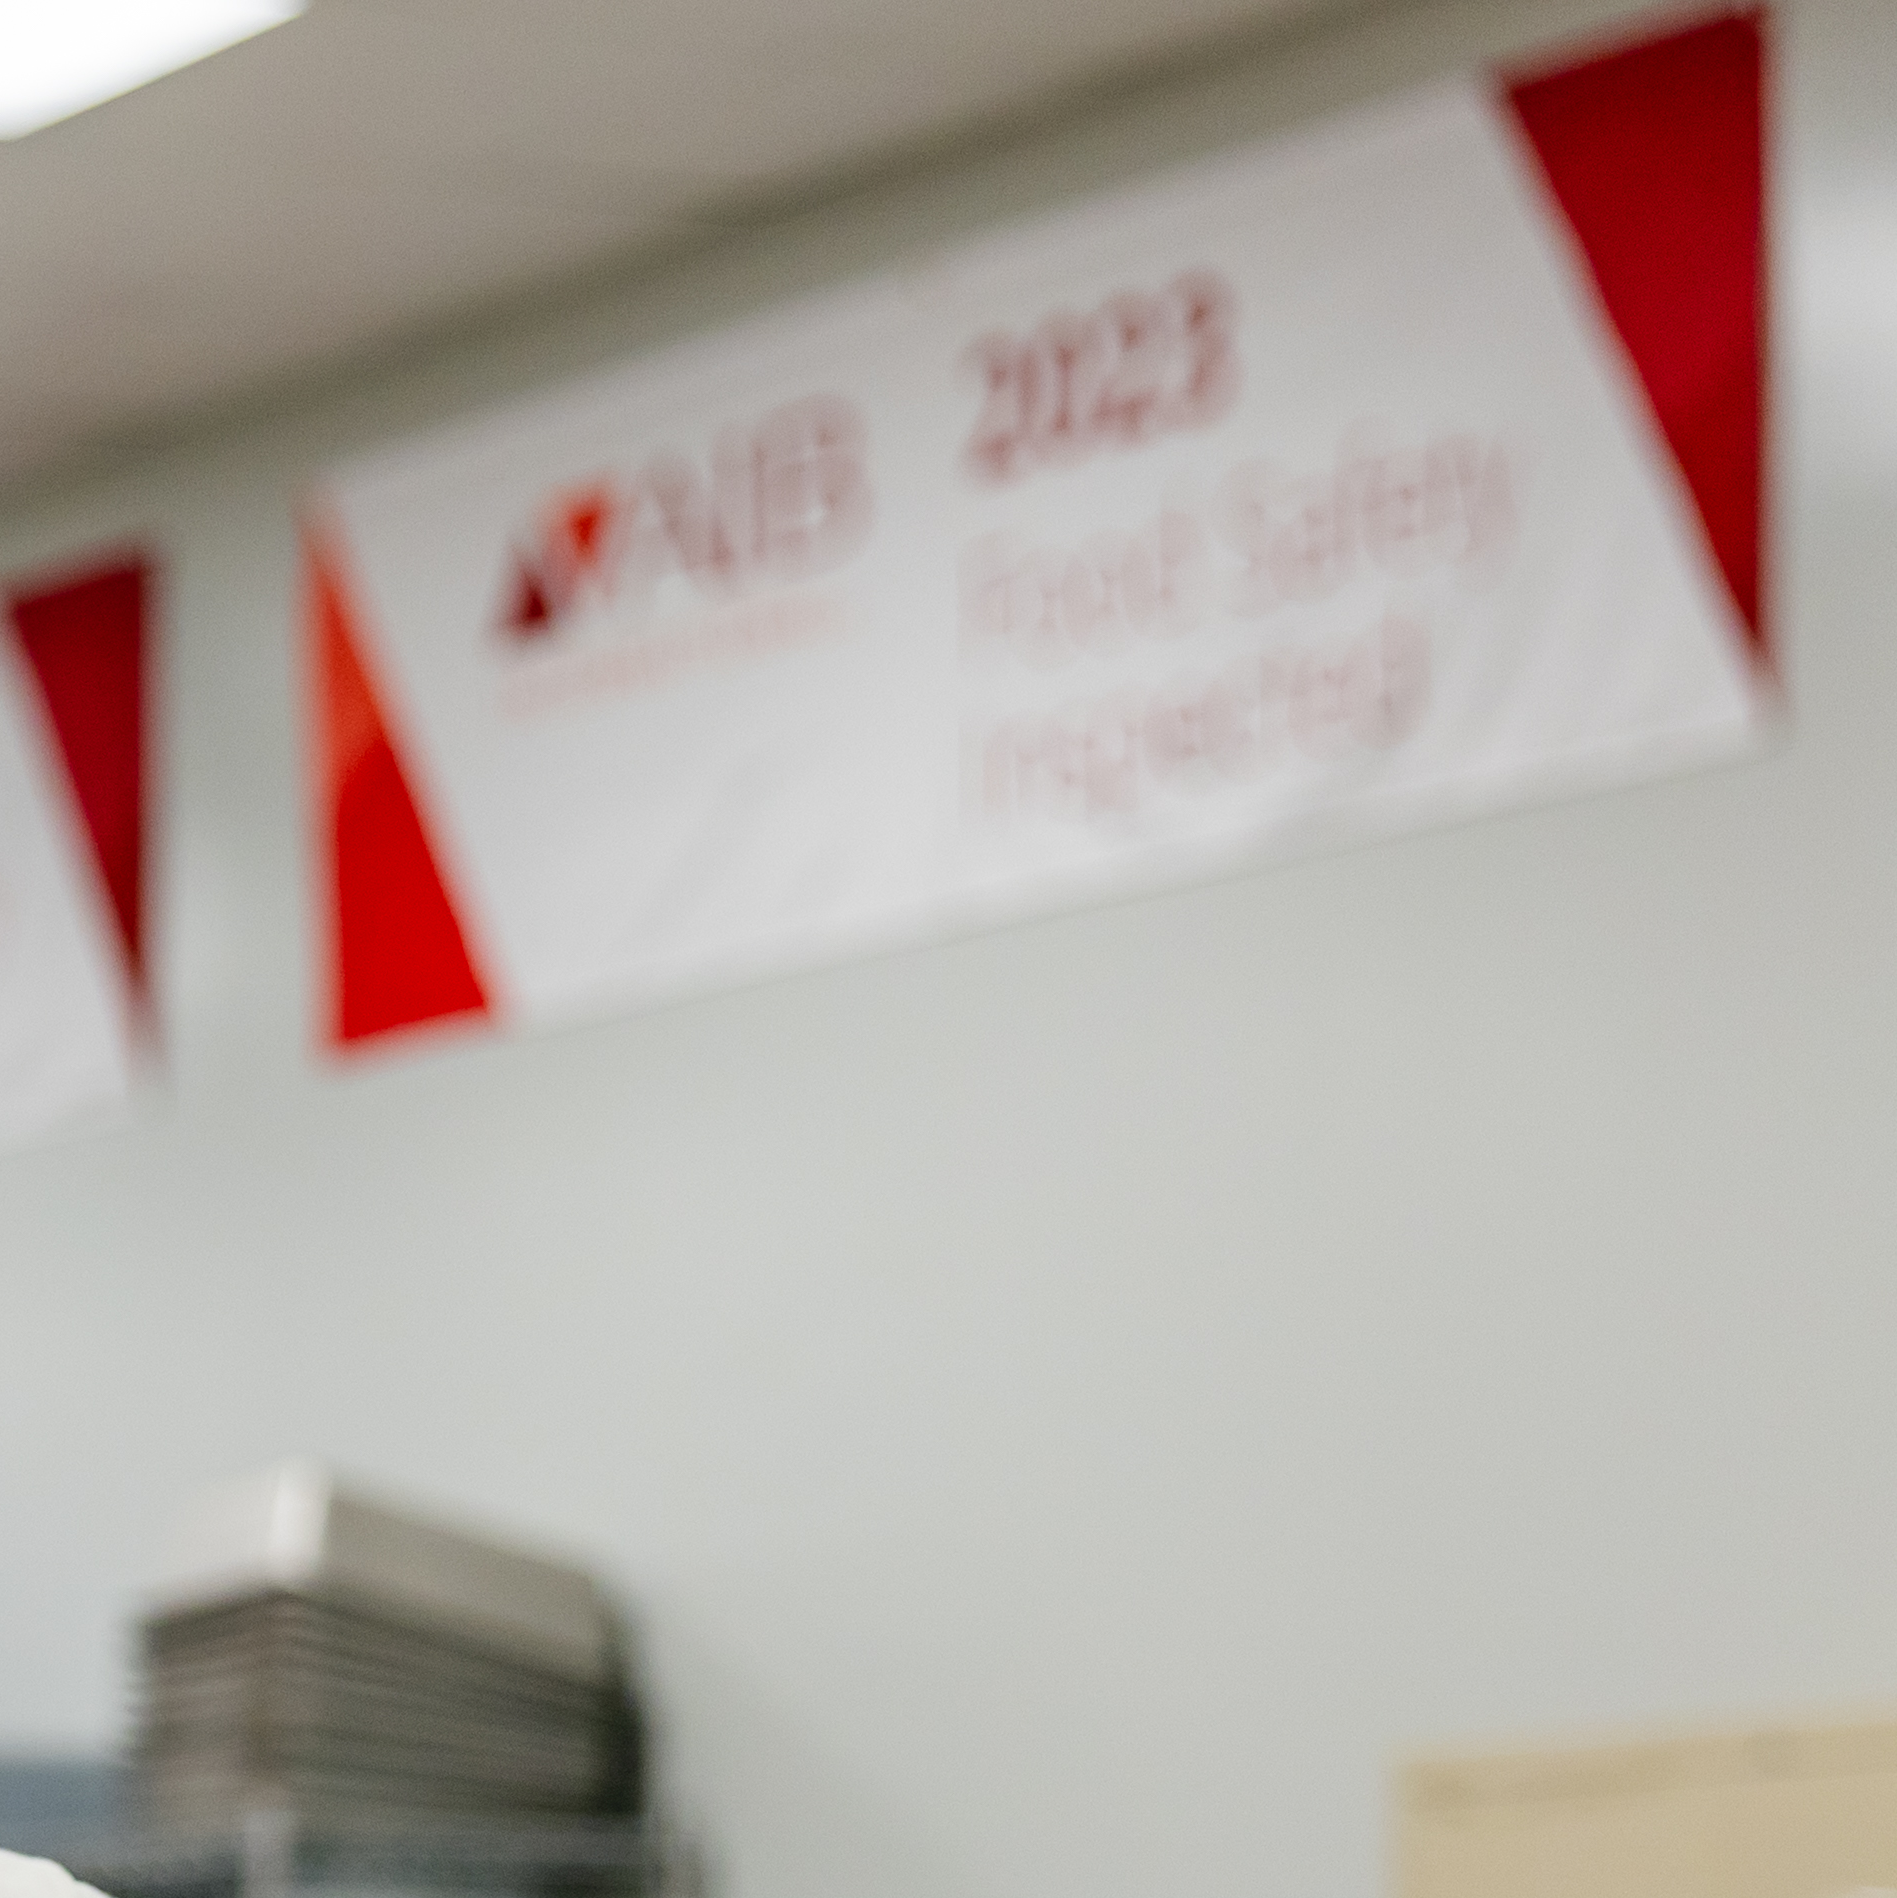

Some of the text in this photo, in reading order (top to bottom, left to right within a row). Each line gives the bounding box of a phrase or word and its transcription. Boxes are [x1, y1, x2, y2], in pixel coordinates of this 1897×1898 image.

[961, 270, 1241, 486] 2023
[965, 495, 1203, 665] Food
[1223, 420, 1533, 617] Safety
